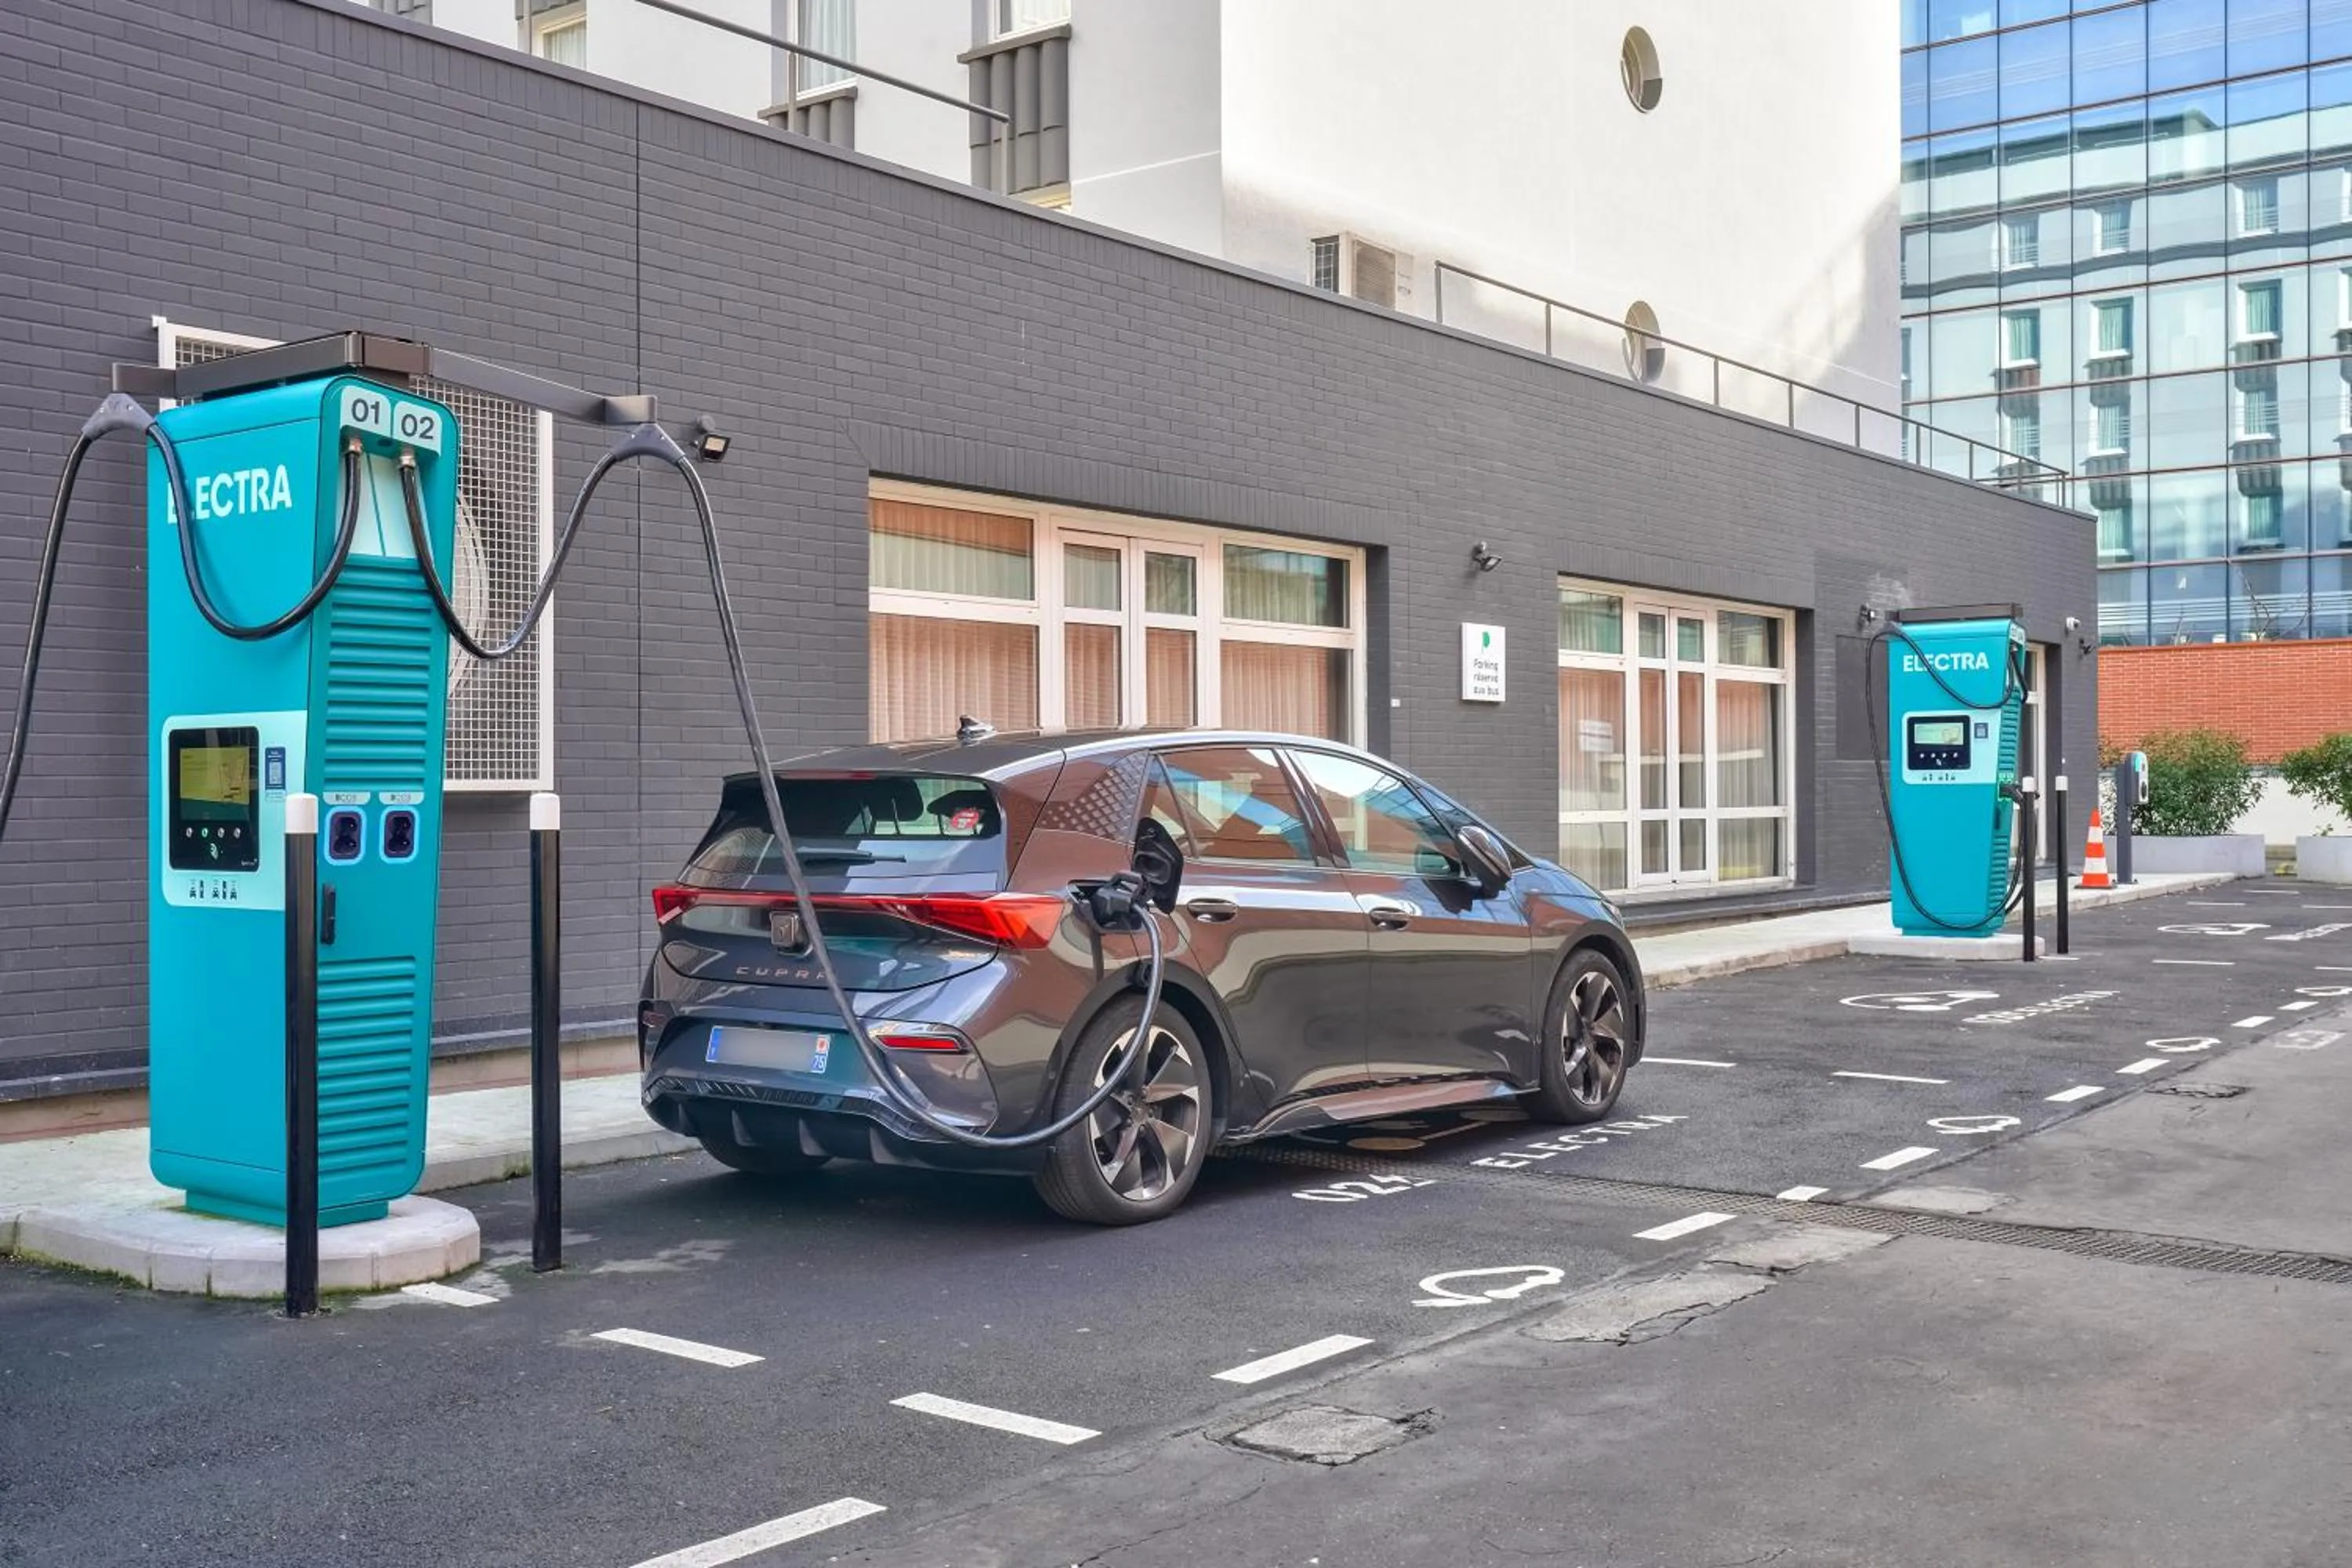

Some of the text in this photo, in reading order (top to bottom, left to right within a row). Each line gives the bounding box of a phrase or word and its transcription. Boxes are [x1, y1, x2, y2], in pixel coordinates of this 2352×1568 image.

[351, 398, 380, 424] 01
[401, 413, 434, 439] 02
[167, 463, 292, 524] ECTRA
[1470, 1114, 1689, 1169] ELECTRA
